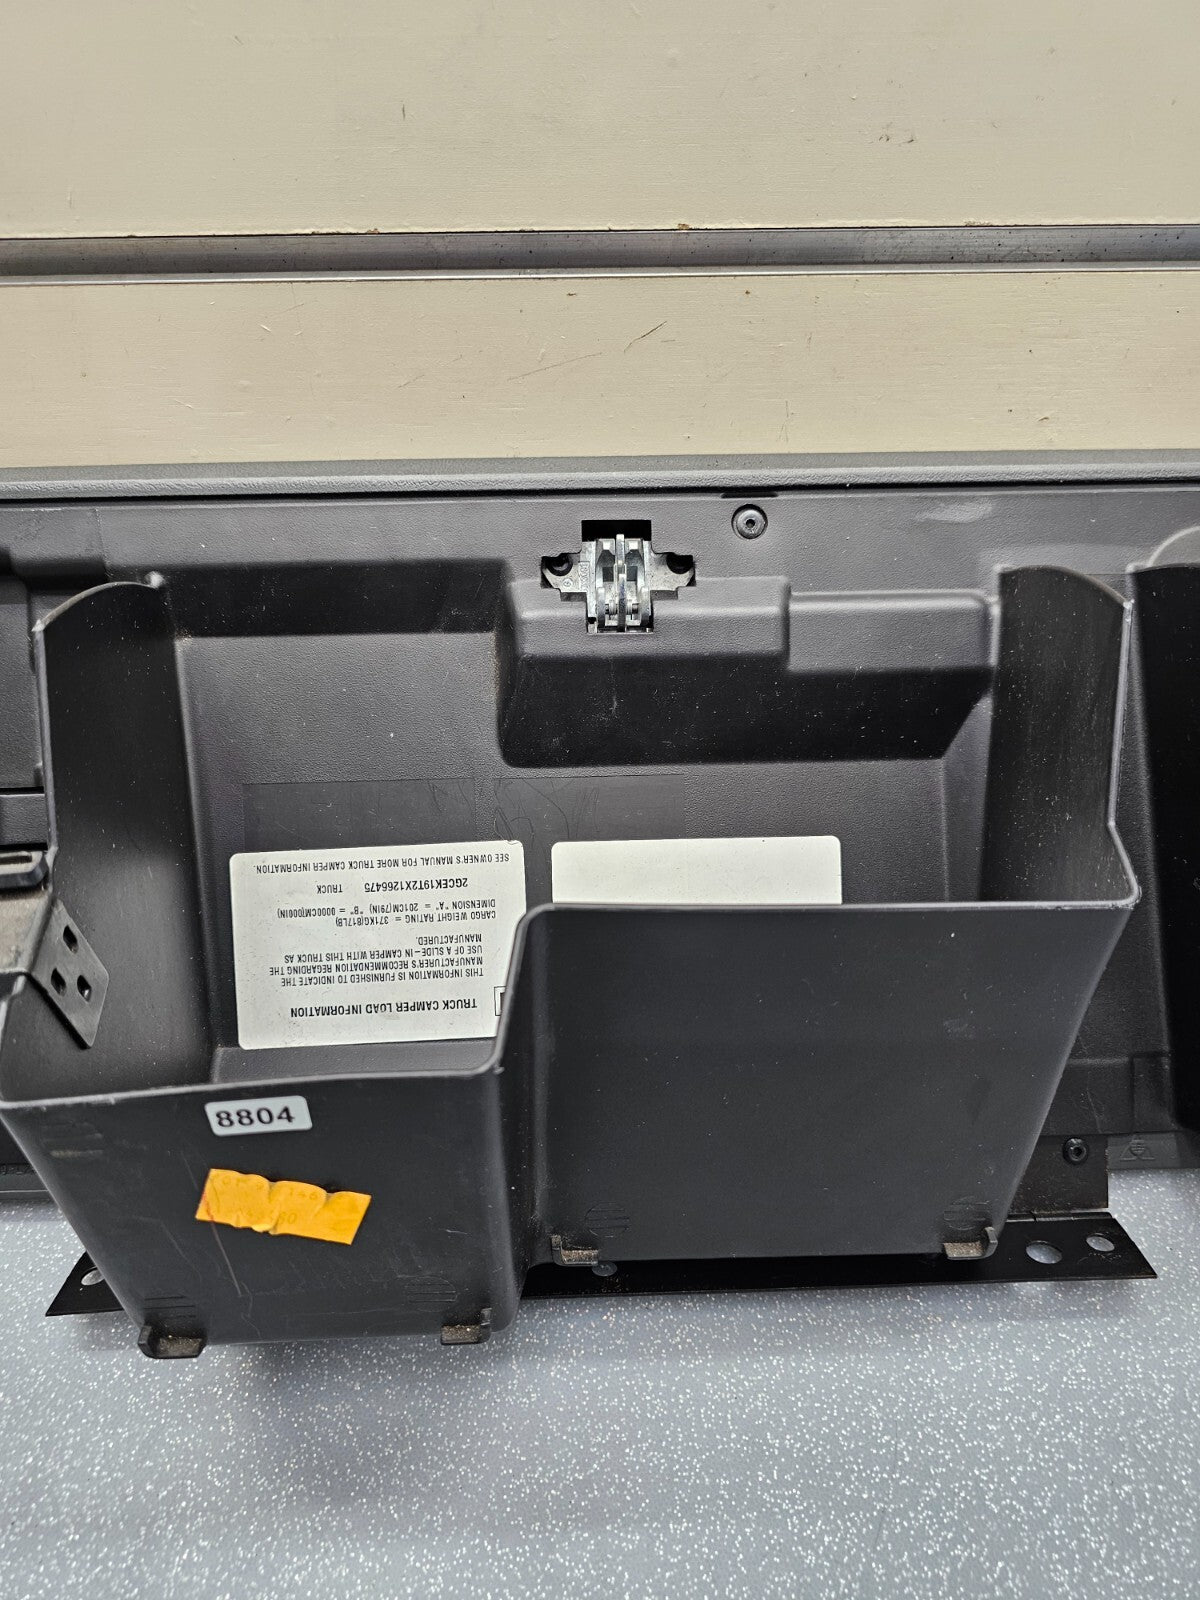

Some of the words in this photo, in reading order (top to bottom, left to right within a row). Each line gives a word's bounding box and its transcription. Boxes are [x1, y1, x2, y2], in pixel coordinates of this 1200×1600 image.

[401, 858, 418, 867] FOR
[420, 856, 453, 866] MANUAL
[456, 854, 493, 864] OWNER'S
[495, 853, 509, 863] SEE
[253, 863, 310, 874] INFORMATION.
[313, 861, 345, 872] CAMPER
[348, 860, 375, 870] TRUCK
[377, 859, 399, 869] MORE
[316, 884, 343, 894] TRUCK
[364, 877, 468, 893] 2GCEK19T2X1266475
[369, 903, 418, 914] 201CM(79IN)
[436, 901, 449, 910] "A"
[452, 899, 496, 910] DIMENSION
[350, 905, 363, 915] "B"
[470, 910, 496, 920] CARGO
[335, 916, 389, 927] 371KG(817LB)
[405, 913, 434, 924] RATING
[437, 912, 468, 922] WEIGHT
[416, 933, 482, 946] MANUFACTURED.
[369, 949, 402, 959] CAMPER
[446, 946, 452, 955] A
[454, 946, 465, 955] OF
[467, 945, 482, 954] USE
[284, 954, 294, 964] AS
[297, 953, 323, 963] TRUCK
[325, 952, 344, 962] THIS
[346, 951, 367, 960] WITH
[335, 960, 409, 972] RECOMMENDATION
[411, 956, 483, 969] MANUFACTURER'S
[269, 967, 285, 976] THE
[287, 964, 332, 975] REGARDING
[409, 969, 463, 980] INFORMATION
[465, 968, 484, 977] THIS
[299, 976, 335, 986] INDICATE
[337, 975, 348, 984] TO
[350, 972, 395, 983] FURNISHED
[398, 972, 406, 981] IS
[281, 978, 297, 987] THE
[365, 1003, 392, 1014] LOAD
[395, 1000, 439, 1012] CAMPER
[442, 998, 478, 1010] TRUCK
[290, 1004, 362, 1018] INFORMATION
[215, 1106, 295, 1127] 8804
